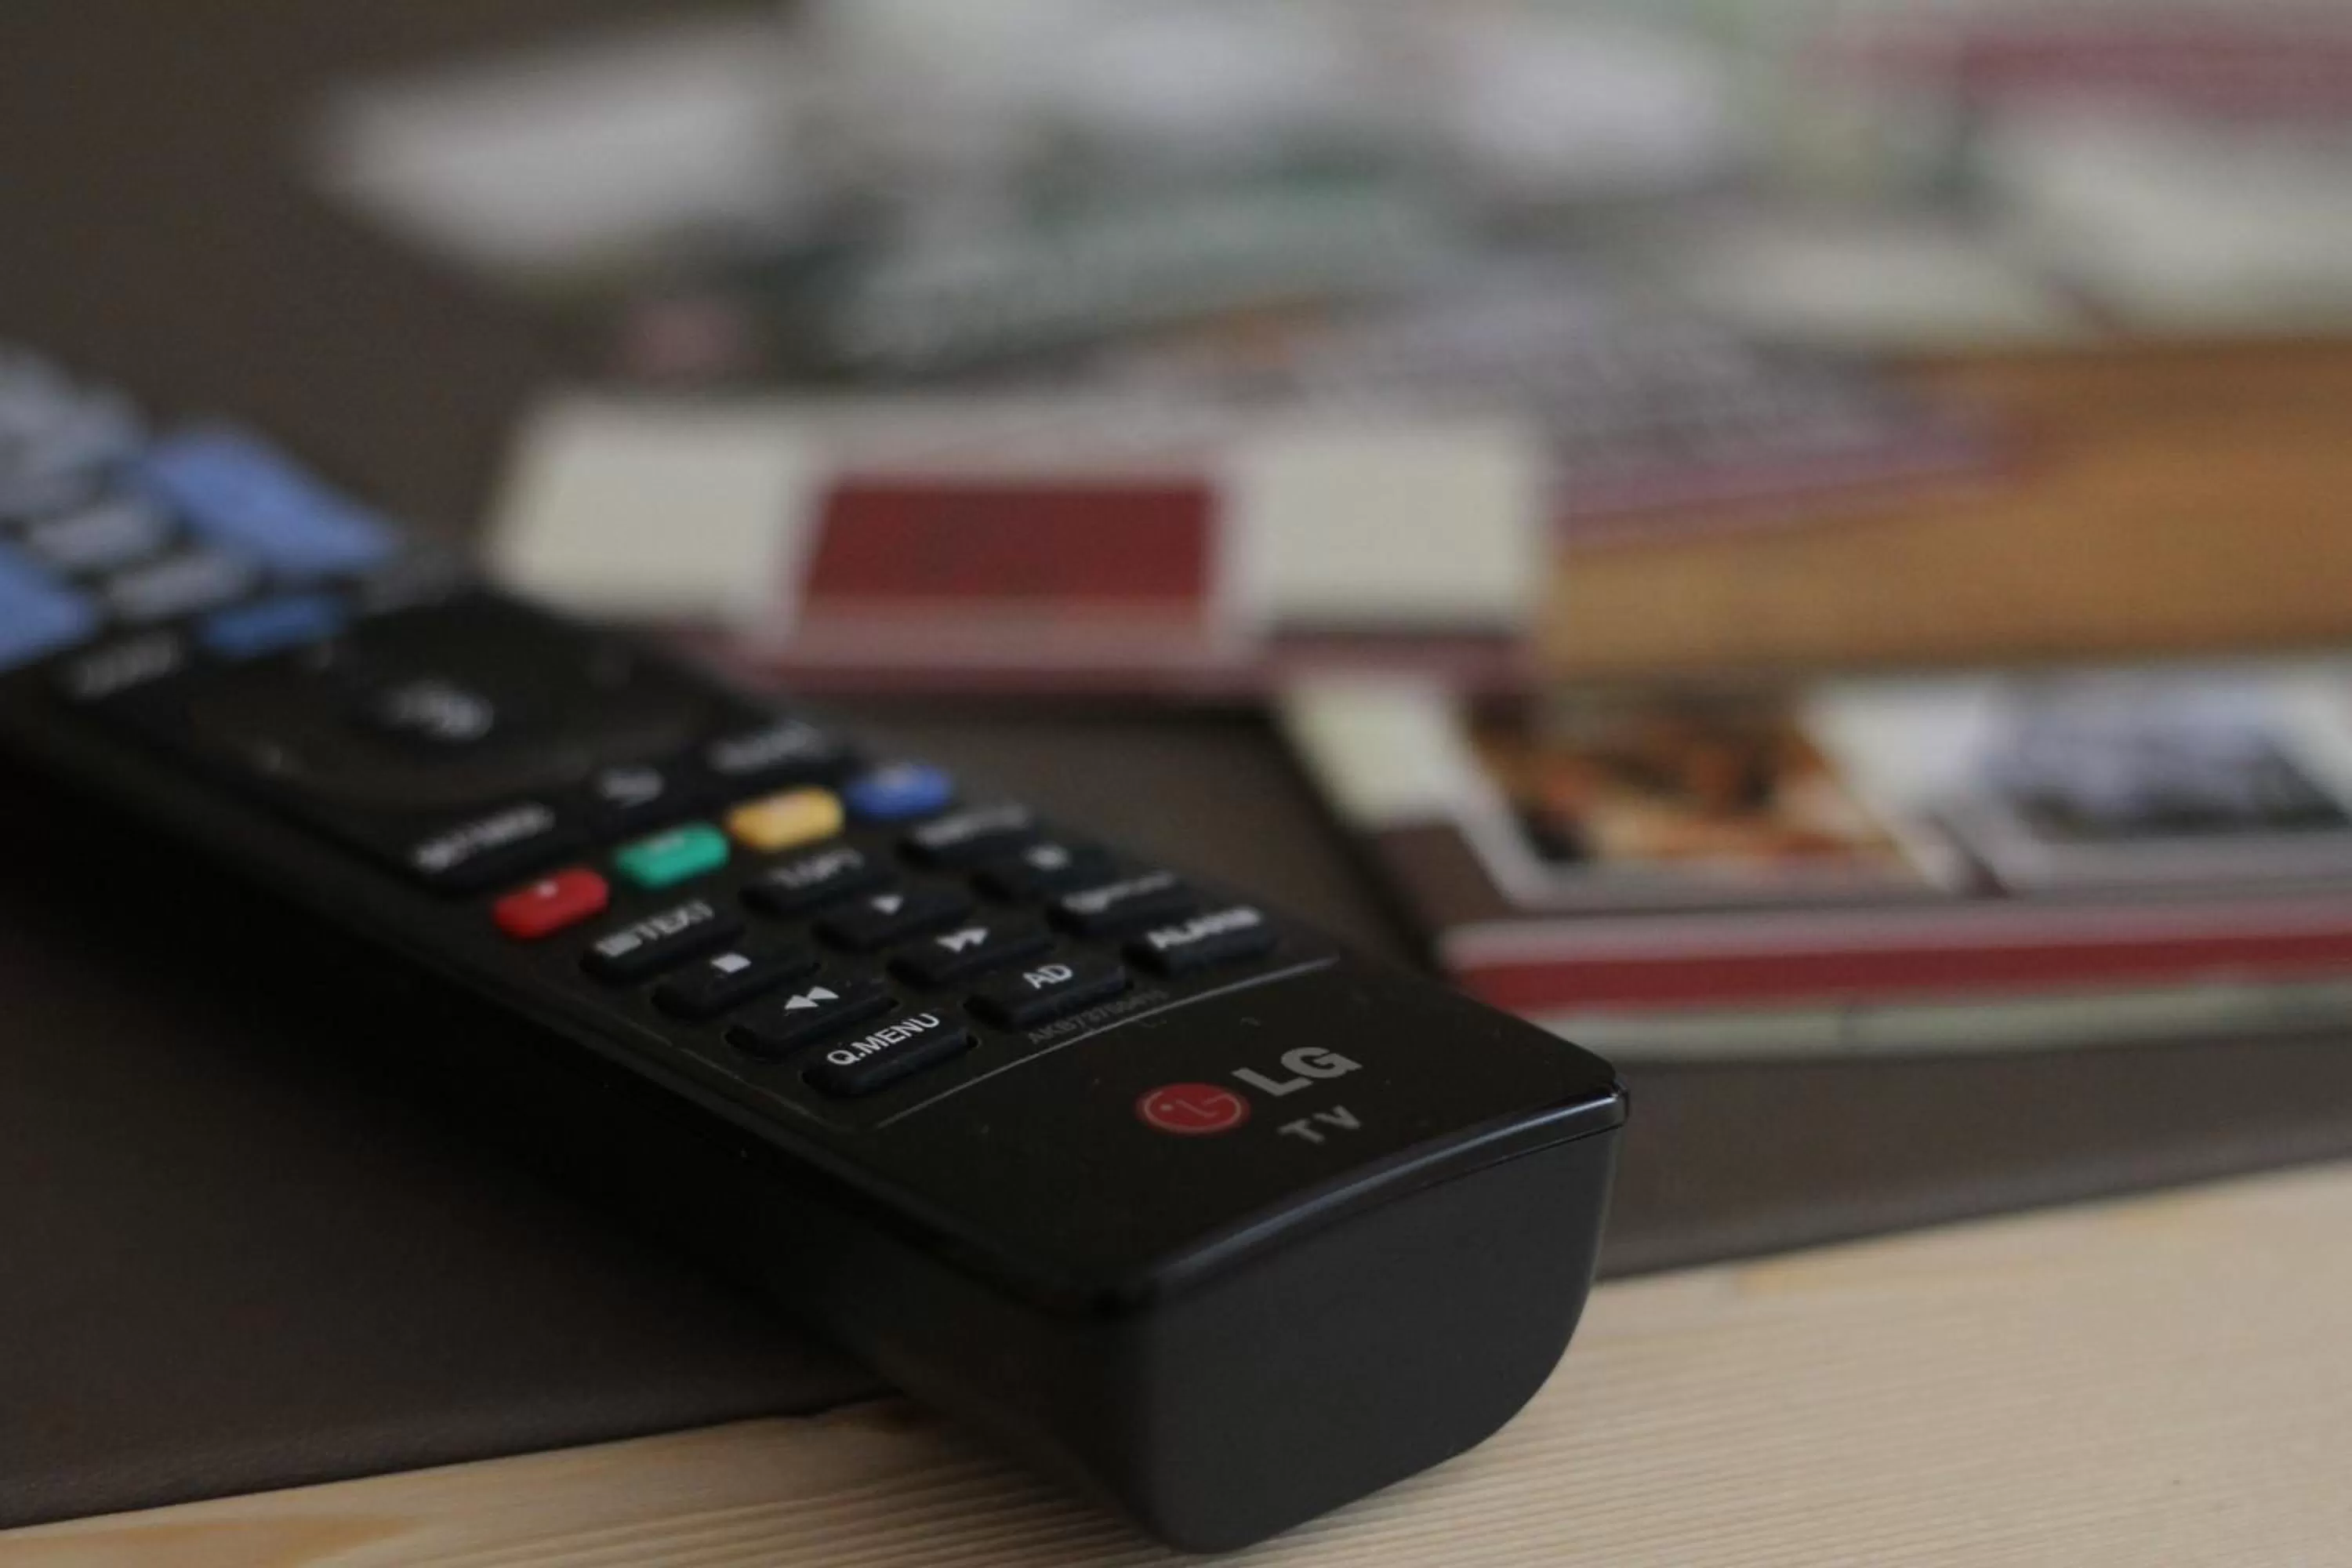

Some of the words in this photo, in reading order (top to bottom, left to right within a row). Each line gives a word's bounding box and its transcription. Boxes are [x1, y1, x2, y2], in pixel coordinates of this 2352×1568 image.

[1022, 963, 1073, 989] AD
[826, 1011, 941, 1067] Q.MENU
[1230, 1047, 1363, 1098] LG
[1277, 1105, 1363, 1145] TV
